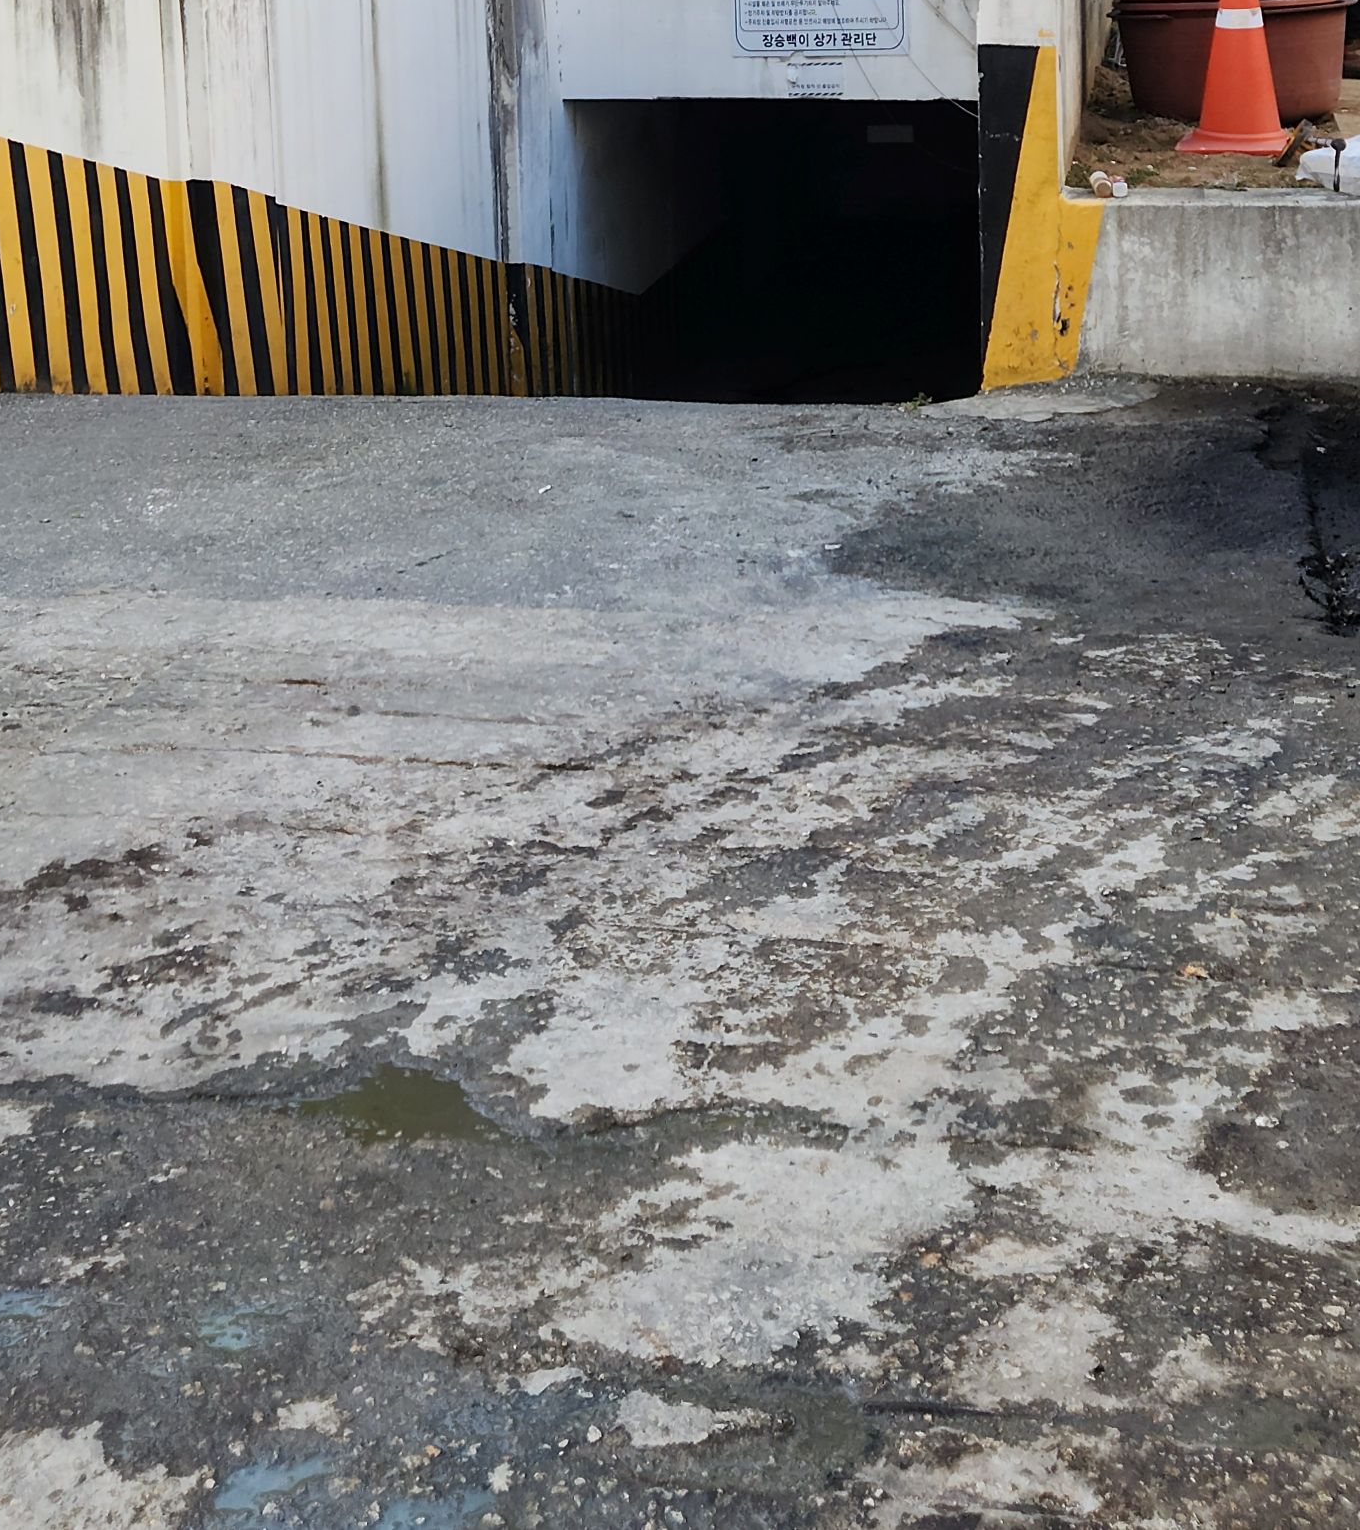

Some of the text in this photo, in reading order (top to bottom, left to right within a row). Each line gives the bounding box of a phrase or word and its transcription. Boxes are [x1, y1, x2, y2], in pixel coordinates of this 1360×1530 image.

[762, 32, 877, 47] 장승백이 상가 관리단
